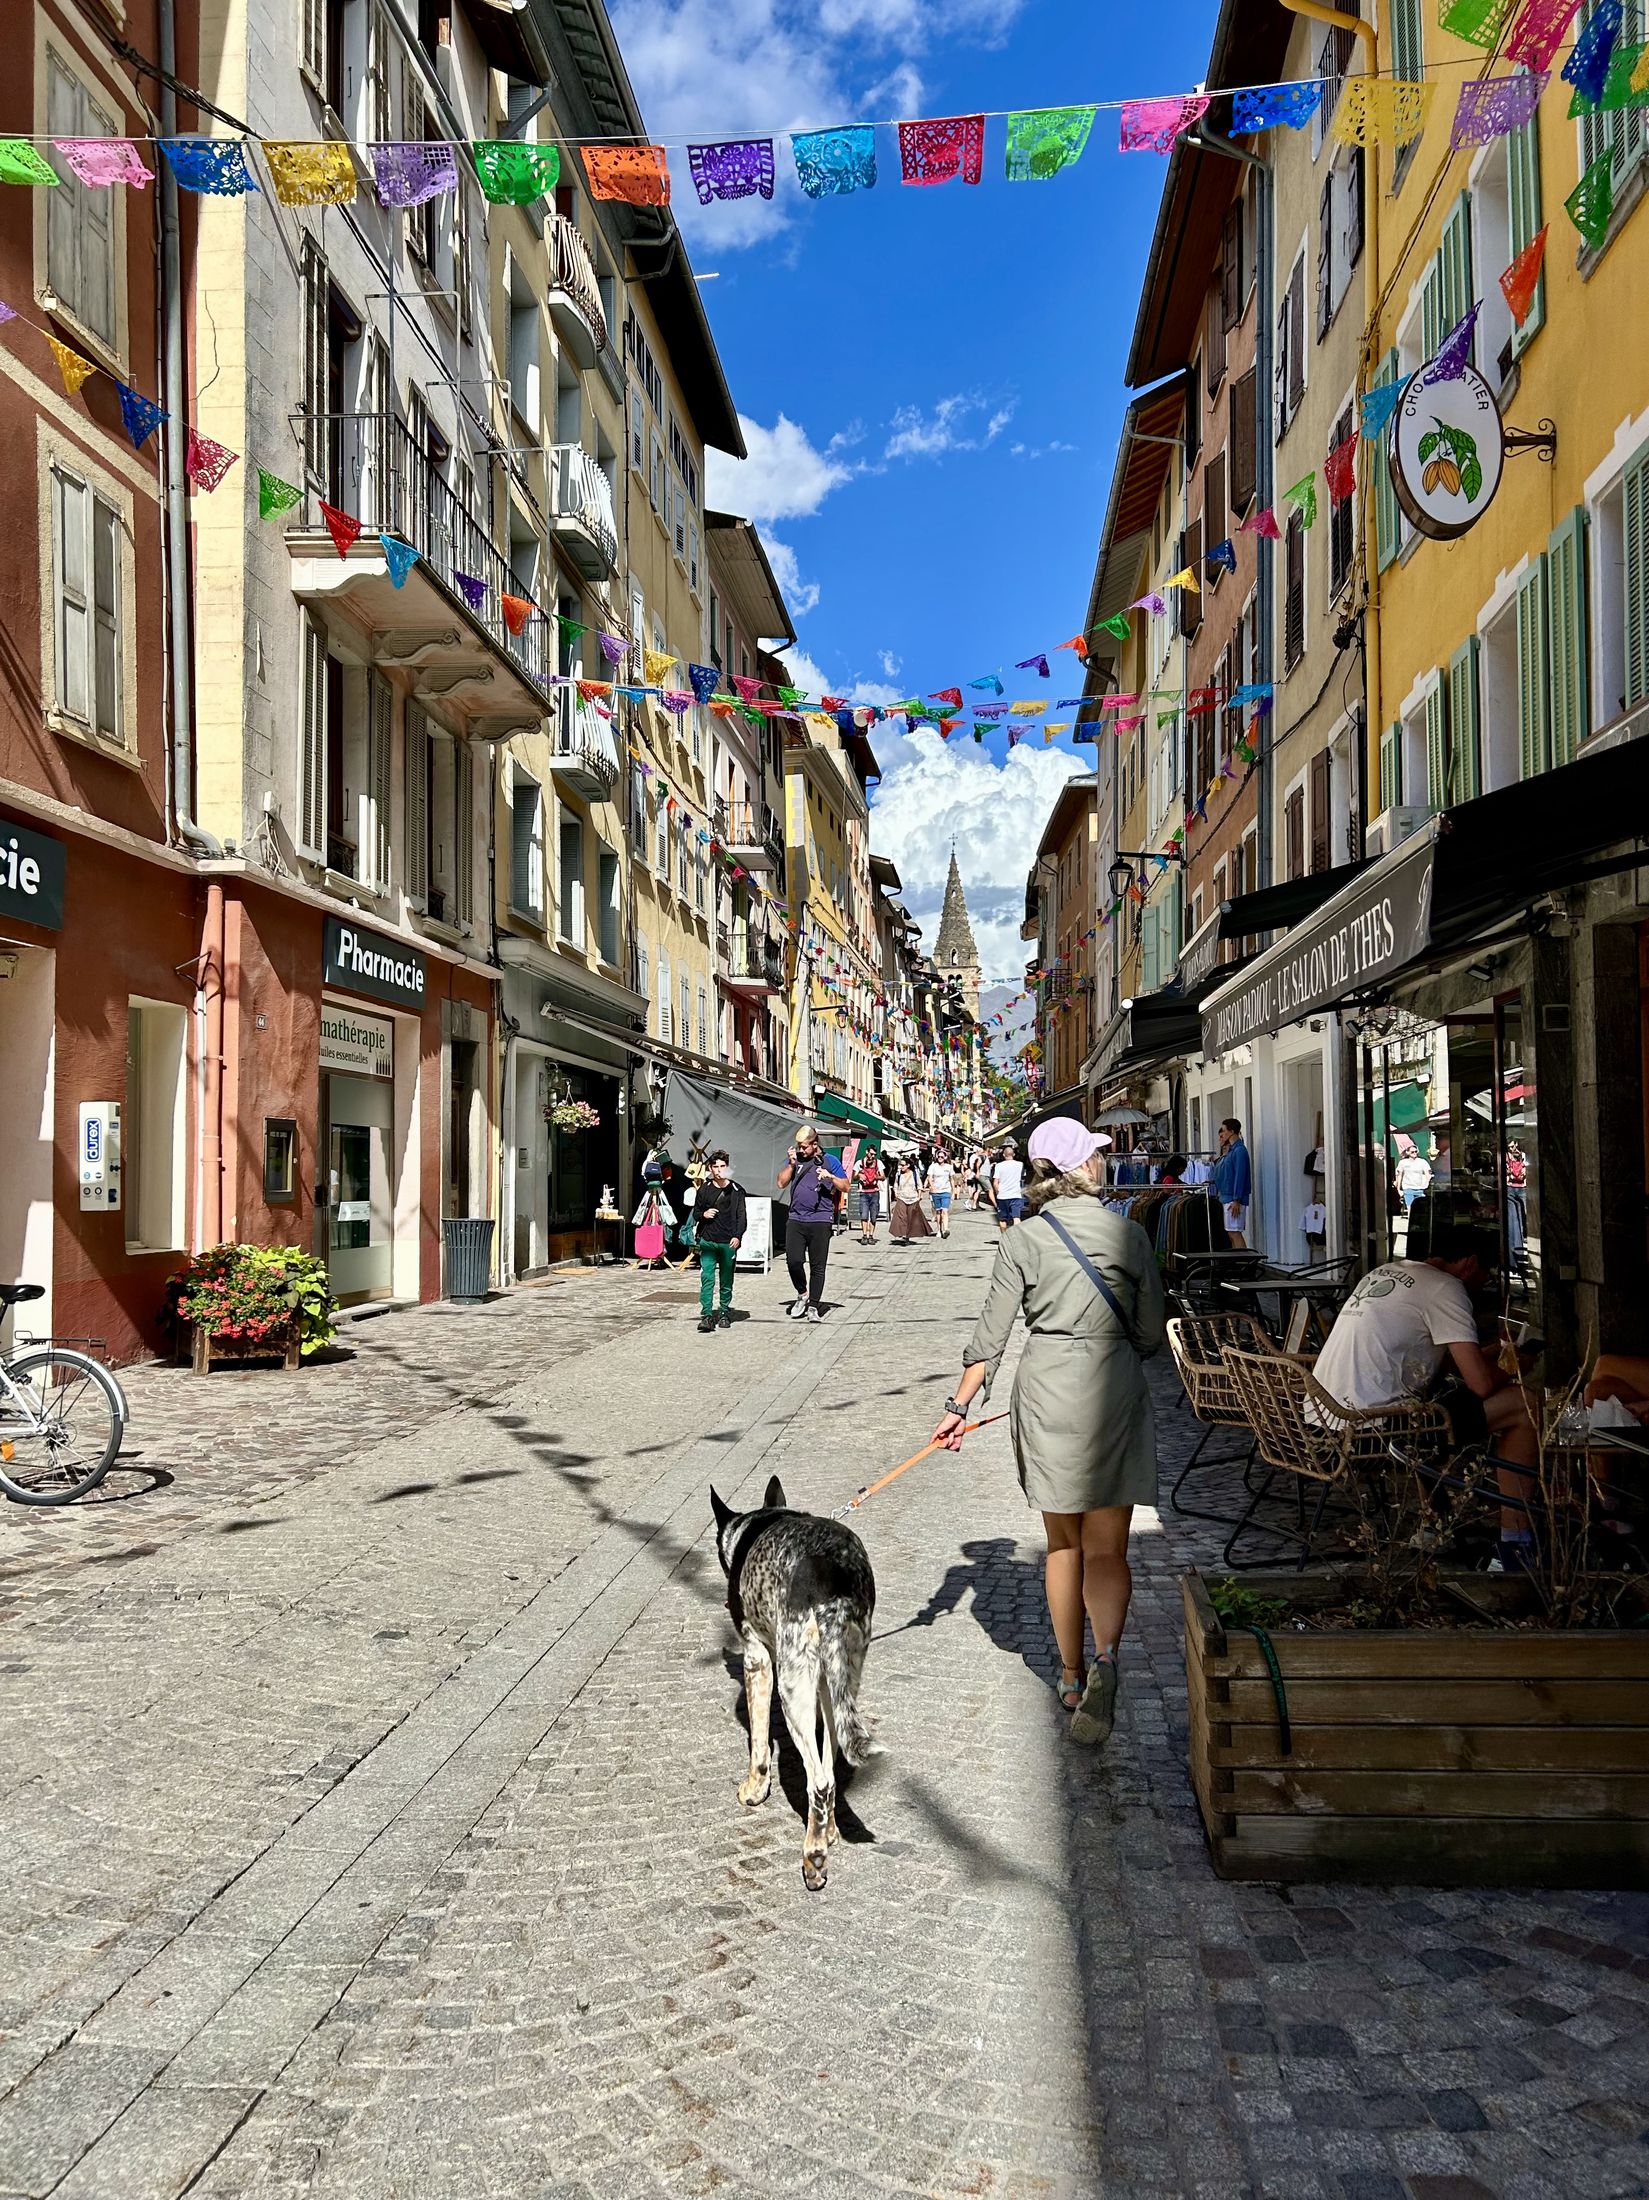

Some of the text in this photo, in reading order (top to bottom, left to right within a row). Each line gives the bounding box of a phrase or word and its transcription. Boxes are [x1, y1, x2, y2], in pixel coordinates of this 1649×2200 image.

[1405, 370, 1489, 417] CHOATIER
[337, 928, 424, 993] Pharmacie
[1215, 998, 1242, 1048] MAISON
[1242, 978, 1272, 1033] PADIOU
[1277, 965, 1290, 1015] LE
[1291, 941, 1328, 1006] SALON
[1330, 927, 1349, 987] DE
[1351, 898, 1394, 974] THES
[320, 1018, 385, 1053] mathérapie
[319, 1046, 369, 1065] uiles essentielles
[87, 1121, 99, 1158] durex
[797, 1164, 804, 1174] 7
[1389, 1270, 1415, 1288] CLUB
